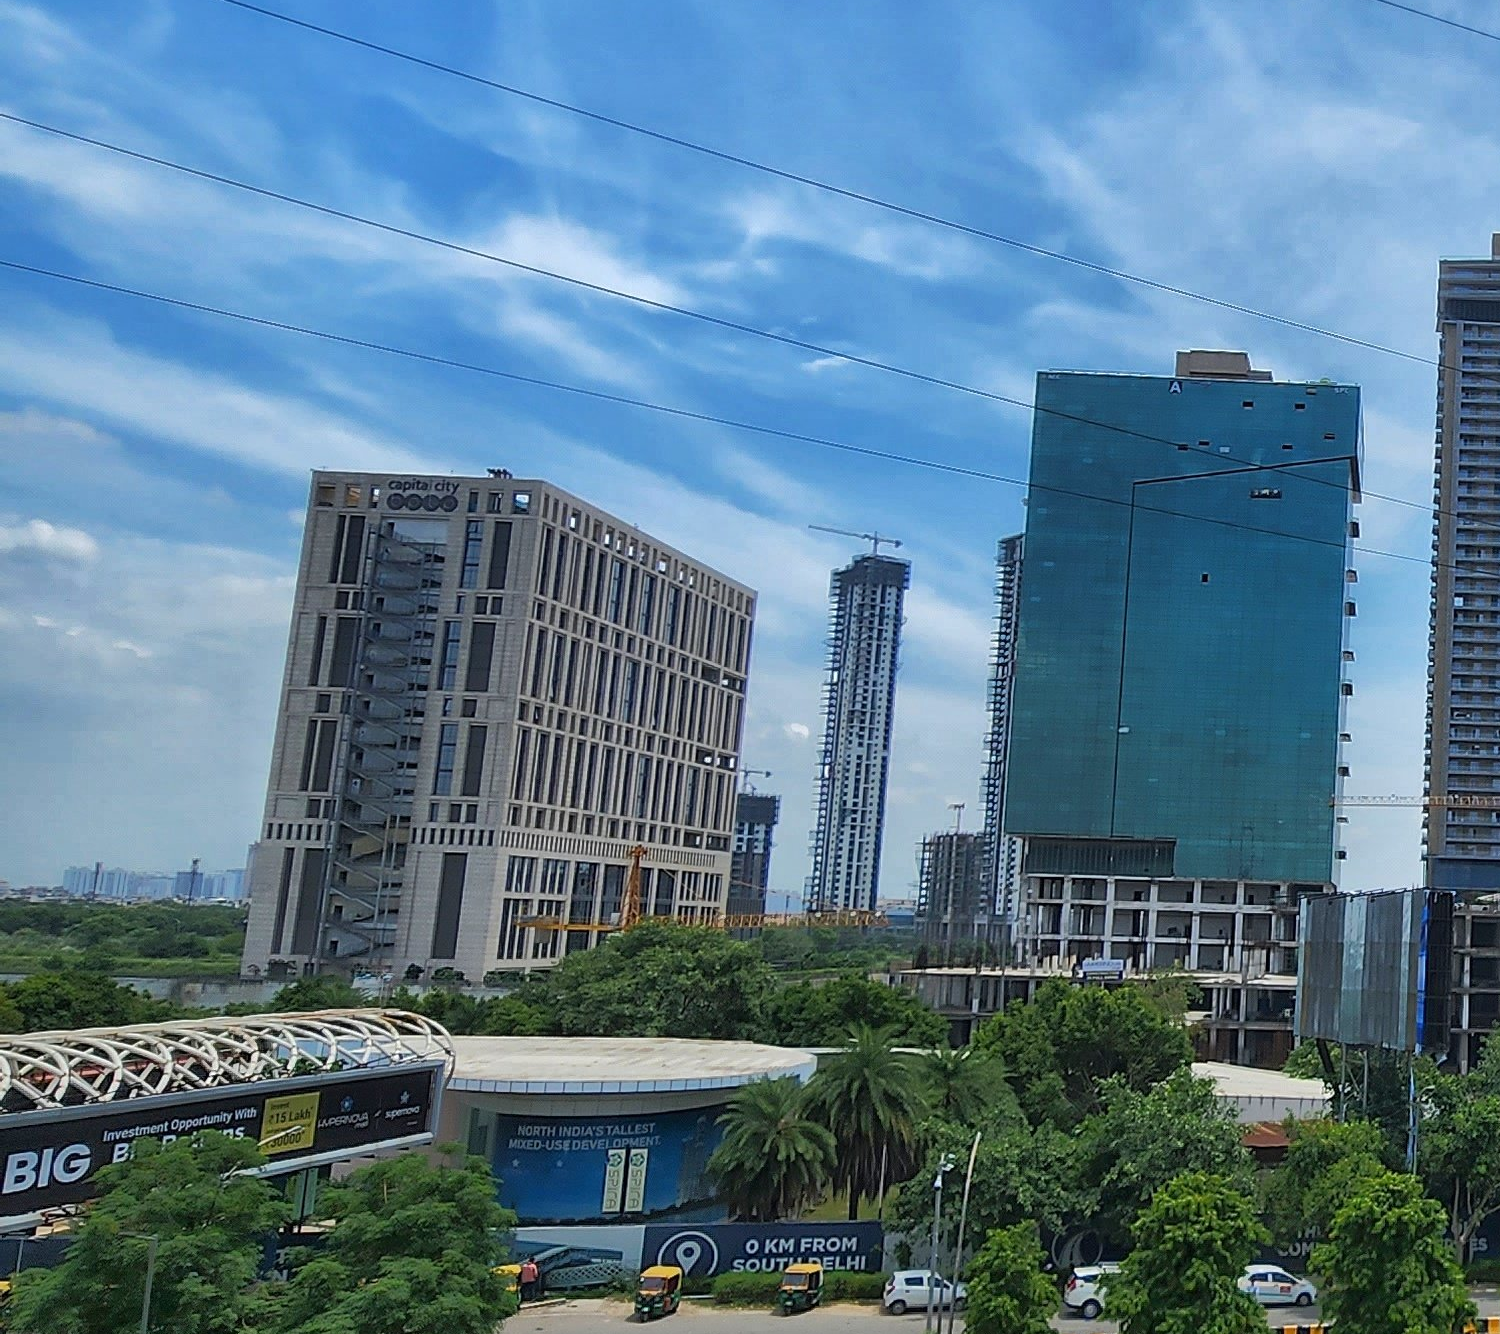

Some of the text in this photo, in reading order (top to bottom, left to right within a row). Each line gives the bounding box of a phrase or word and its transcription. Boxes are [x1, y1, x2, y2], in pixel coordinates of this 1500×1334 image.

[434, 480, 460, 495] city
[102, 1121, 169, 1142] Investment
[170, 1111, 233, 1132] Opportunity
[234, 1107, 258, 1120] With
[518, 1123, 656, 1137] NORTH INDIA'S TALLEST
[508, 1139, 571, 1151] MIXED-USE
[2, 1143, 91, 1195] BIG
[745, 1237, 858, 1255] 0 KM FROM
